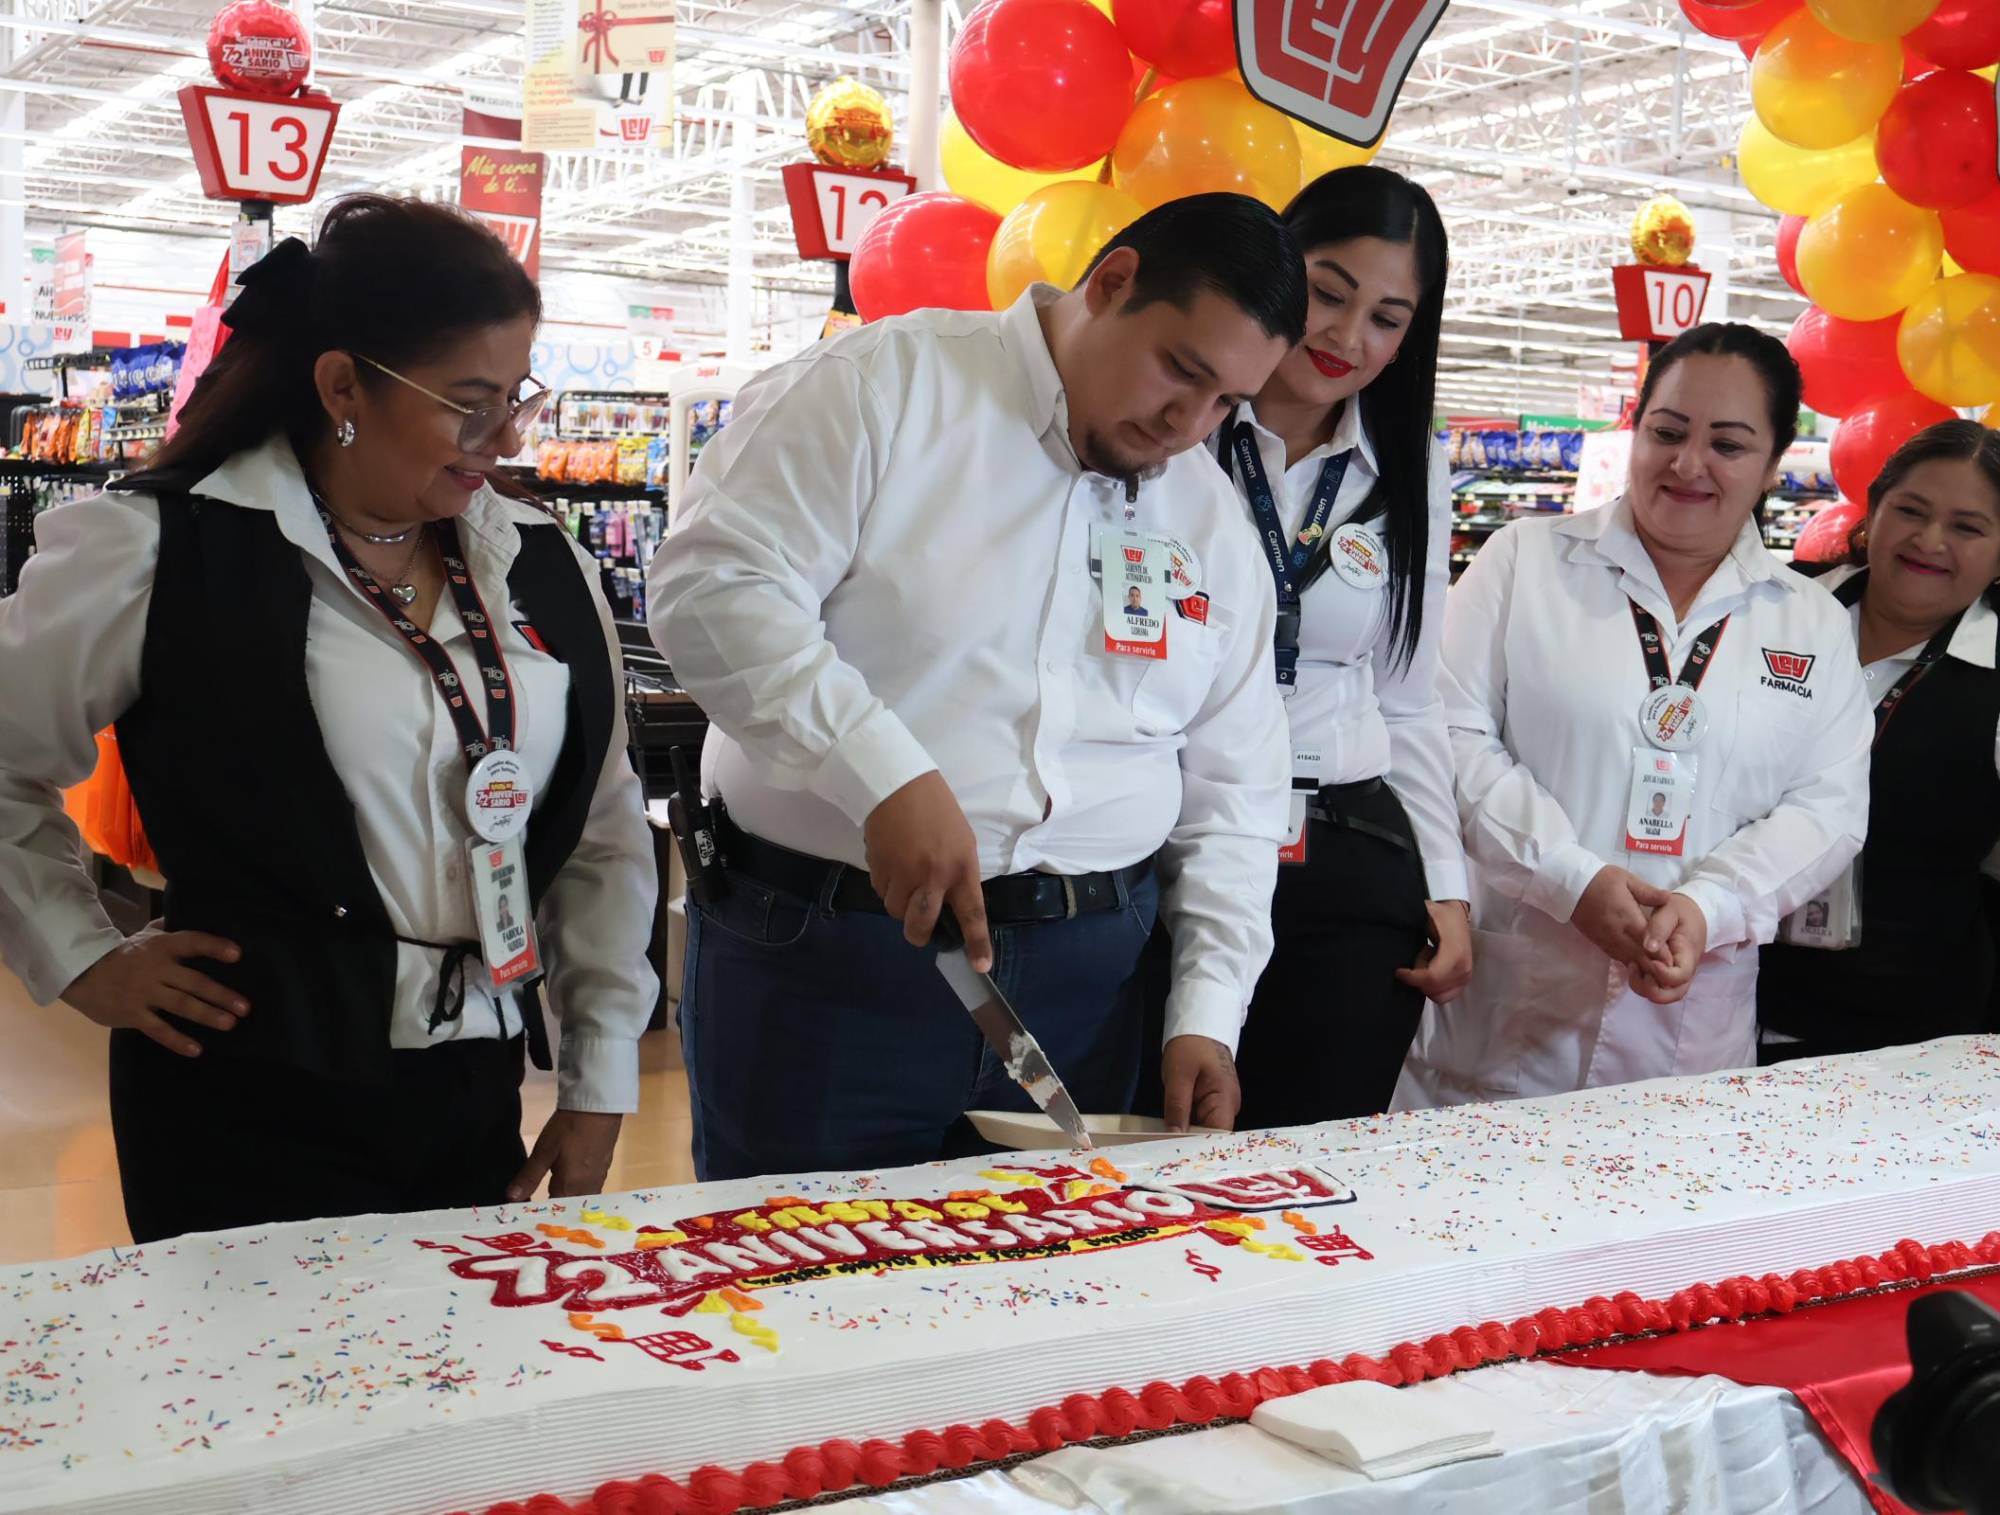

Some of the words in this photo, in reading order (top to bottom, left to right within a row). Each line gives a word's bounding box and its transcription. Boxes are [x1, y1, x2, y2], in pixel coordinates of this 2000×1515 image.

[227, 112, 308, 181] 13
[1654, 280, 1695, 328] 10
[642, 340, 653, 357] 5
[1240, 438, 1257, 479] Carmen
[1268, 530, 1285, 573] Carmen
[1126, 616, 1160, 629] ALFREDO
[1116, 642, 1131, 653] Para
[1132, 645, 1156, 656] servirle
[1761, 675, 1813, 700] FARMACIA
[1639, 817, 1673, 829] ANABELLA
[1636, 840, 1650, 850] Para
[469, 1255, 660, 1300] 72
[656, 1190, 1195, 1282] ANIVERSARIO
